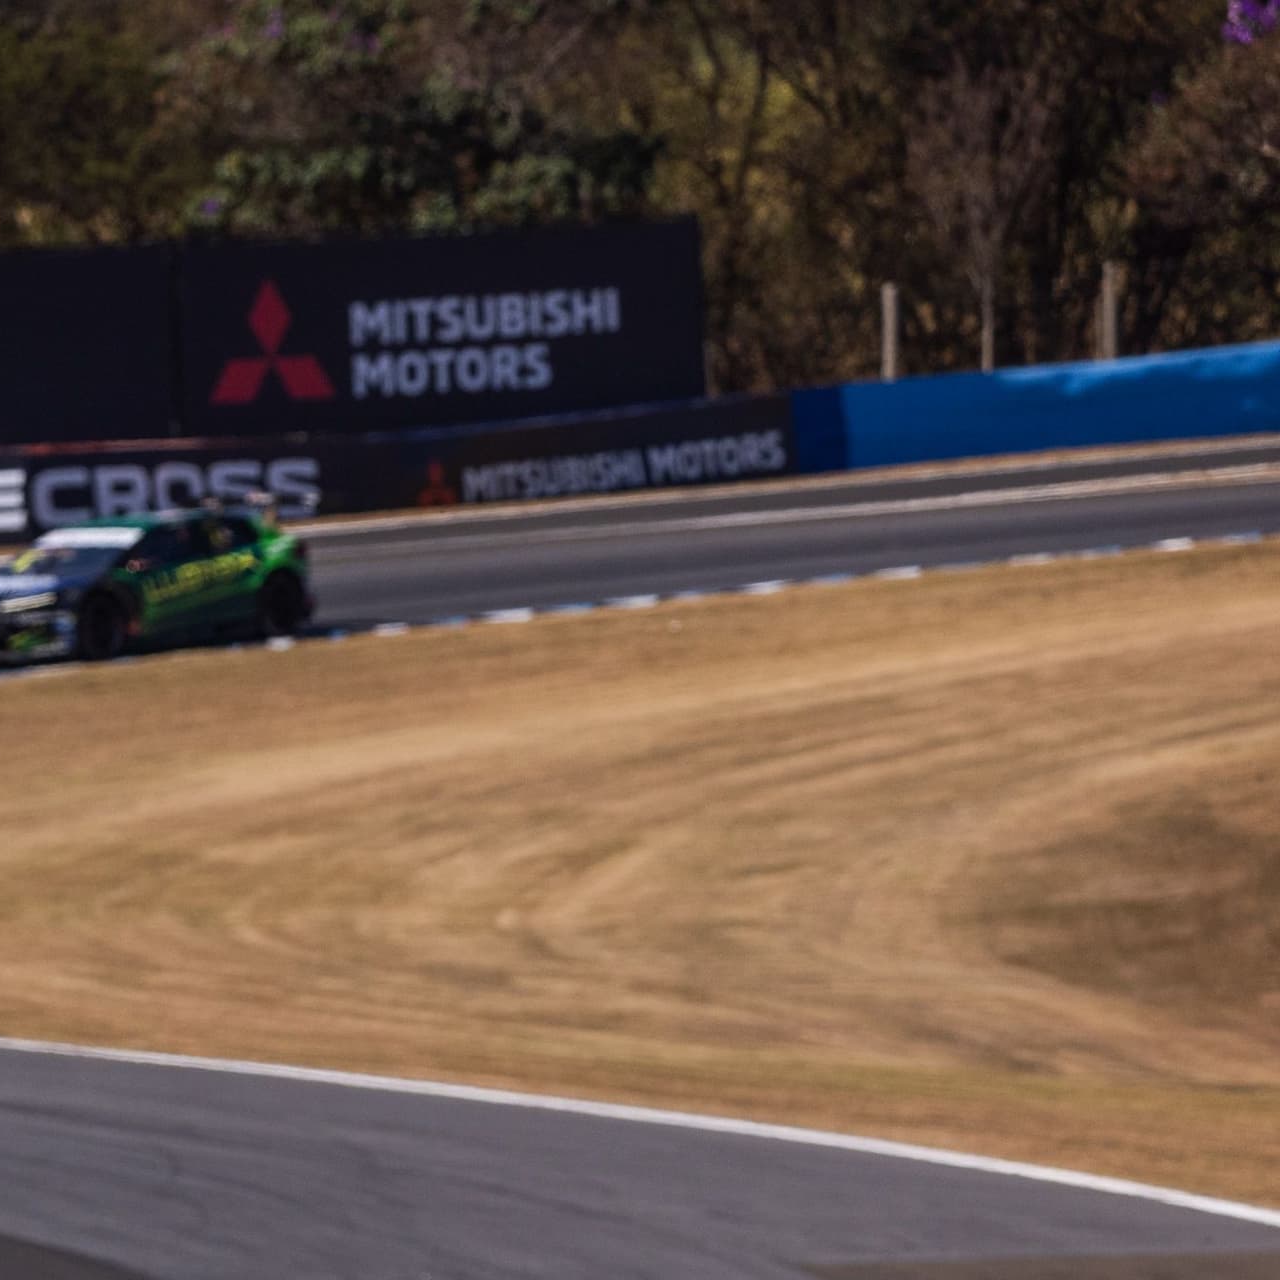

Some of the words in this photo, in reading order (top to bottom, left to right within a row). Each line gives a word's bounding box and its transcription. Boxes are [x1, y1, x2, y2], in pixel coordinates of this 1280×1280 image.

[348, 287, 621, 347] MITSUBISHI
[351, 343, 553, 399] MOTORS
[30, 457, 321, 530] CROSS
[460, 449, 643, 503] MITSUBISHI
[645, 429, 787, 485] MOTORS
